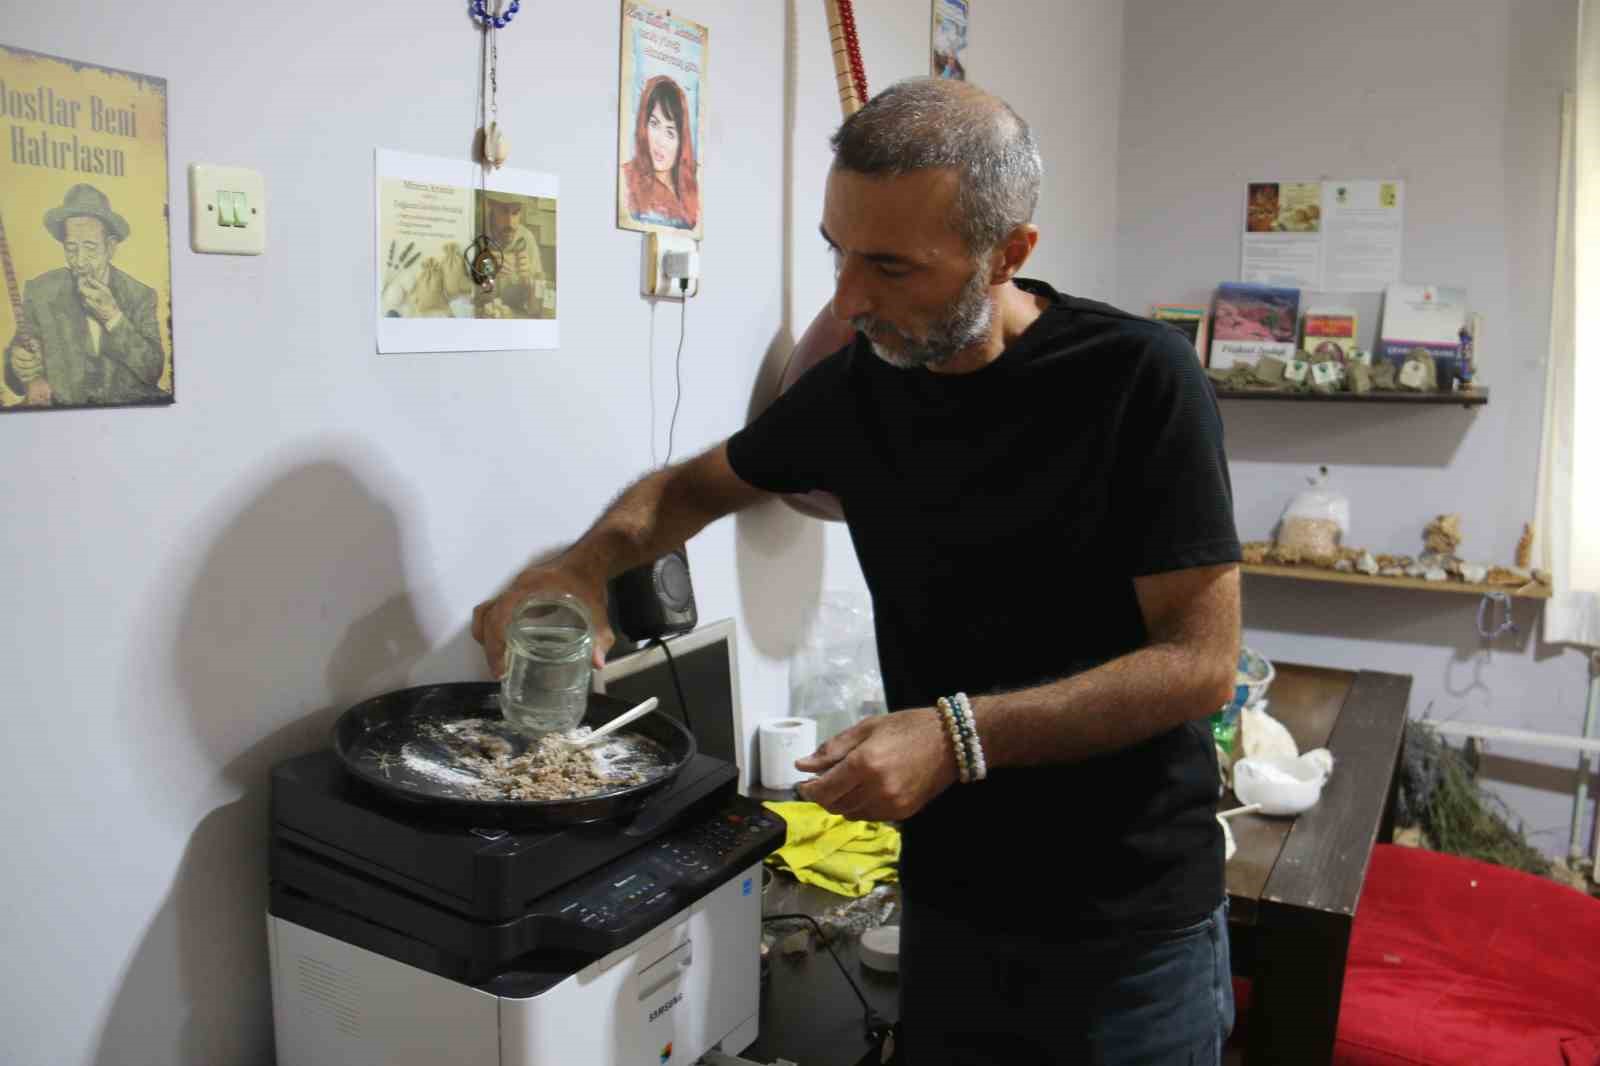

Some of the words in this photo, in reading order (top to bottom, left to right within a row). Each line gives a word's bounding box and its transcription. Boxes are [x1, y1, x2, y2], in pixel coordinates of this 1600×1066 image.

[91, 95, 136, 138] Beni
[10, 124, 124, 177] Hatırlasın
[648, 992, 683, 1023] SAMSUNG
